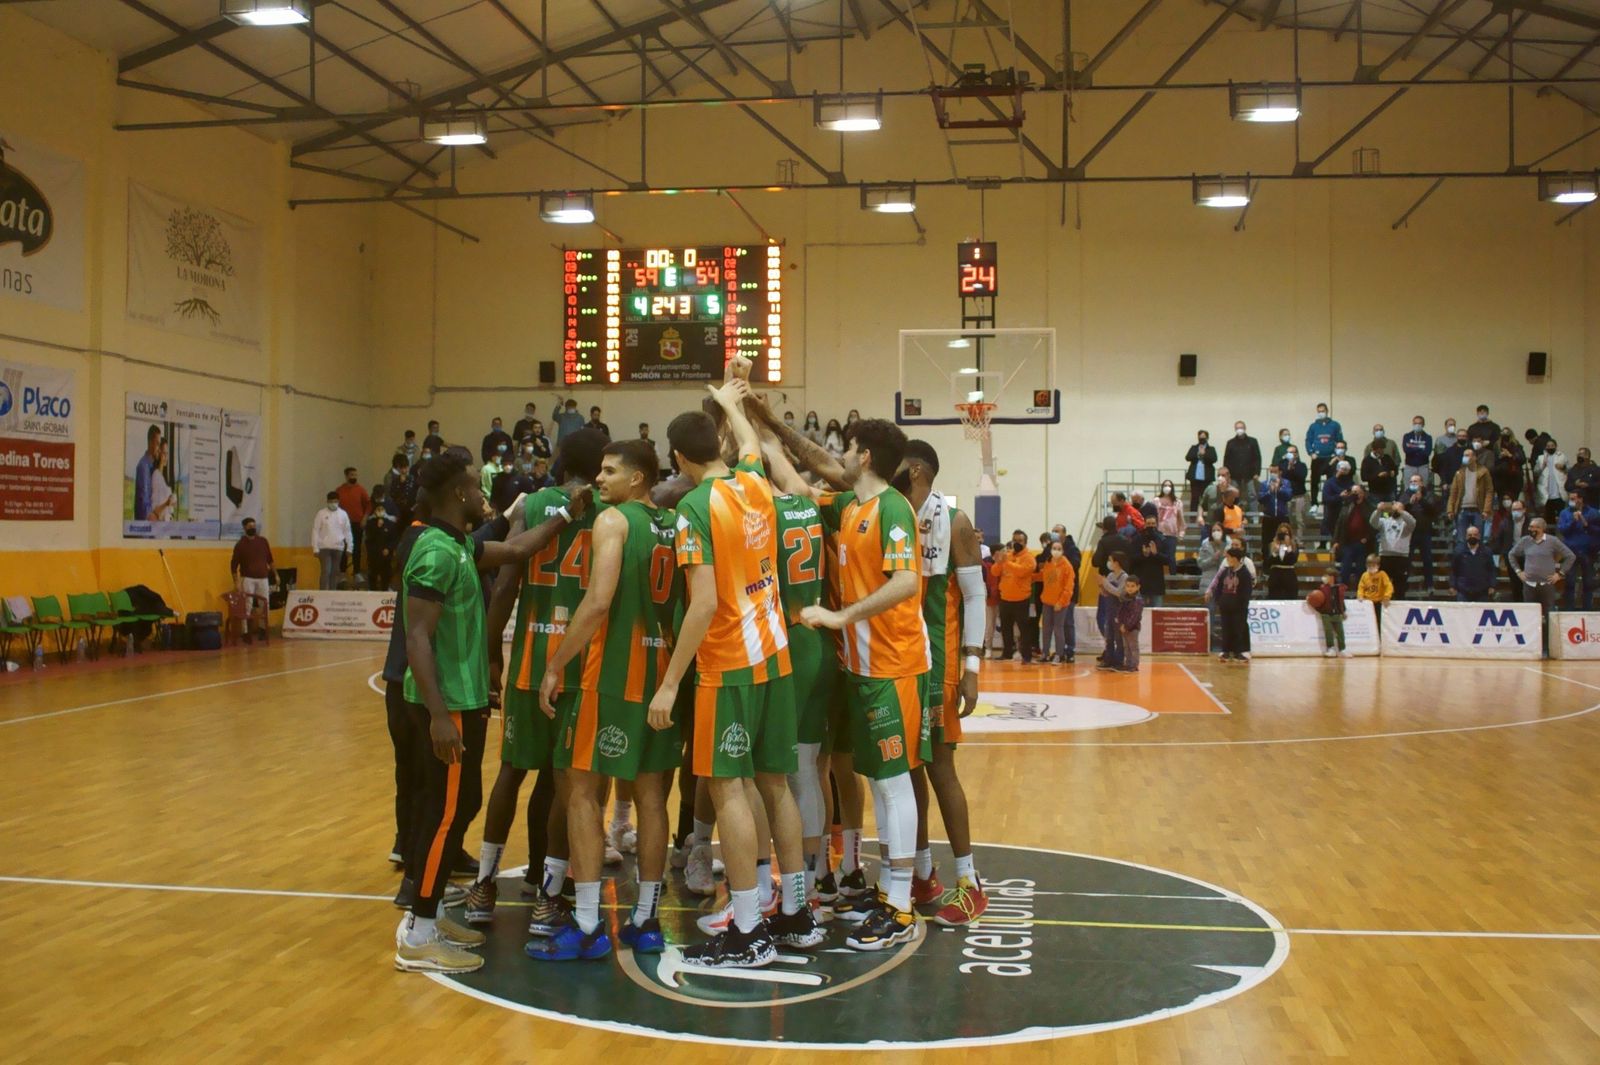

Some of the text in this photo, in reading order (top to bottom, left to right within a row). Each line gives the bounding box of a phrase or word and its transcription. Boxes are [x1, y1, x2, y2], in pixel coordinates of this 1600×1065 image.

[635, 268, 659, 287] 59
[696, 266, 720, 285] 54
[962, 266, 995, 292] 24
[634, 296, 648, 316] 4
[652, 296, 676, 315] 24
[680, 296, 691, 315] 3
[706, 294, 720, 315] 5
[631, 371, 661, 379] MORÓN
[641, 363, 701, 372] Ayuntamiento de
[23, 387, 71, 418] Placo
[133, 401, 160, 417] KOLUX
[23, 421, 69, 435] SAINT-GOBAIN
[32, 453, 70, 470] Torres
[528, 529, 593, 590] 24
[650, 543, 675, 605] 0
[745, 575, 774, 596] max
[293, 607, 314, 623] AB
[877, 734, 903, 762] 16
